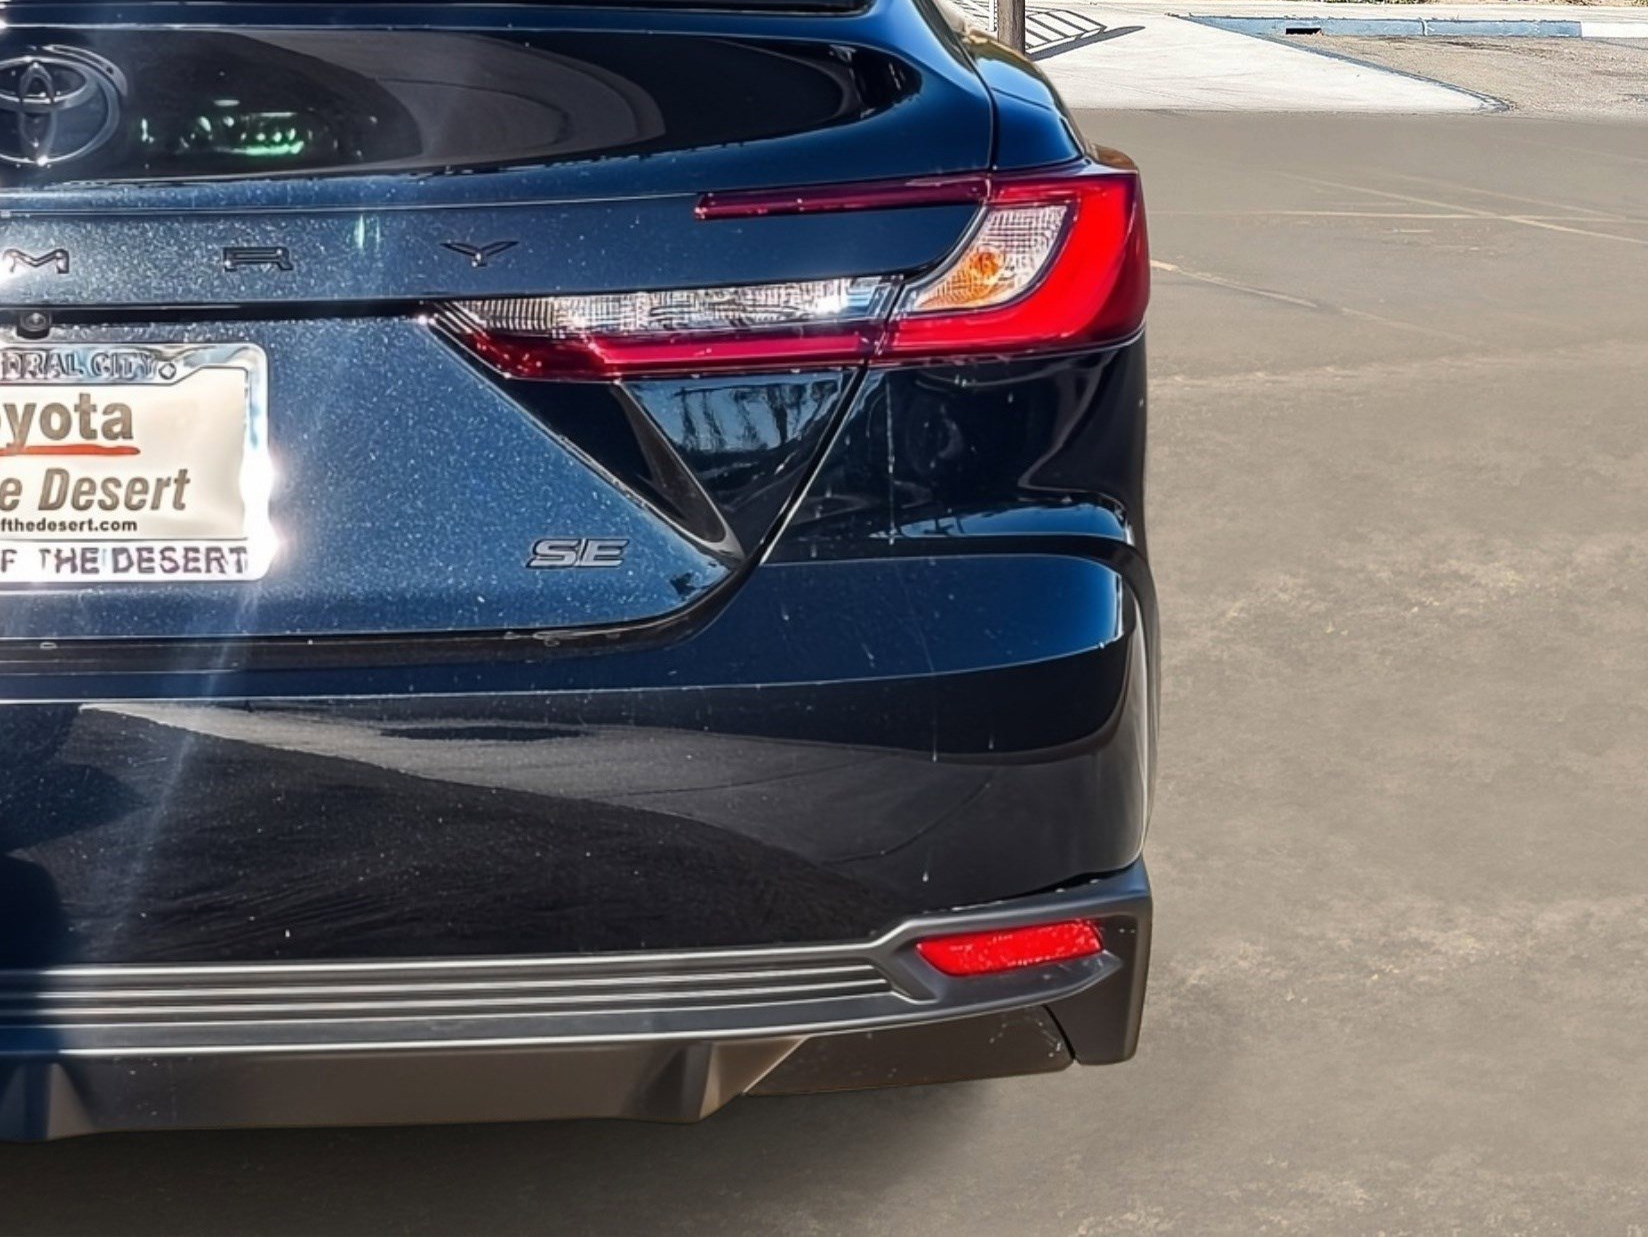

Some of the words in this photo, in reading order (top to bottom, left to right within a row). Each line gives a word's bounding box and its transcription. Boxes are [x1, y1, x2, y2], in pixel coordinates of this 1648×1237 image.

[89, 350, 157, 378] CITY
[38, 468, 191, 512] Desert
[38, 547, 100, 575] THE
[110, 546, 248, 575] DESERT
[526, 538, 630, 569] SE
